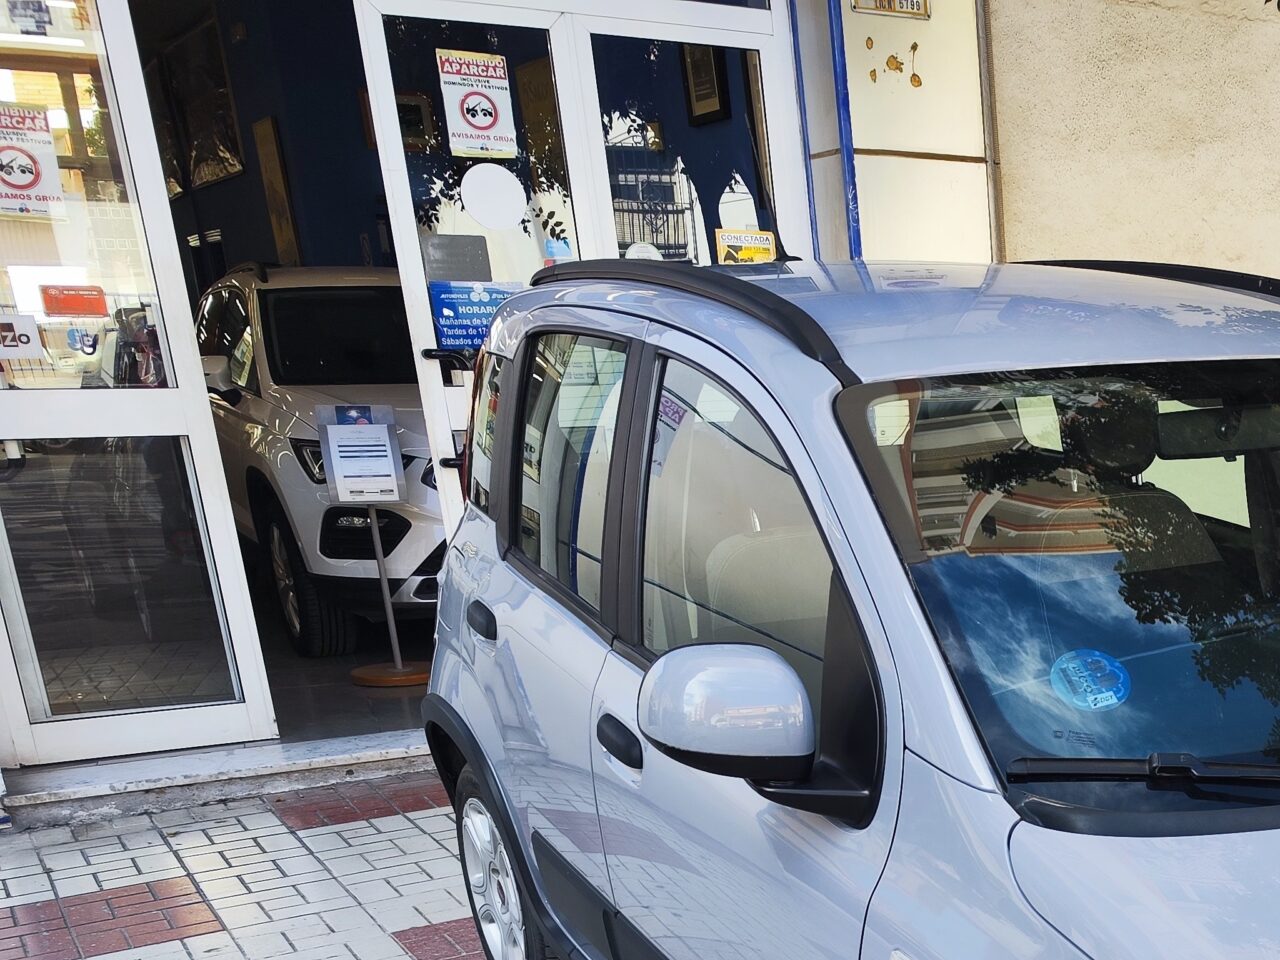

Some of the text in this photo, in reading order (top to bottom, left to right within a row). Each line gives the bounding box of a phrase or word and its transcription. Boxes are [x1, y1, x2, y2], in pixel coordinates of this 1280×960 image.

[443, 63, 506, 78] APARCAR
[443, 80, 475, 88] DOMINGOS
[0, 116, 49, 131] RCAR
[451, 132, 491, 141] AVISAMOS
[721, 234, 770, 242] CONECTADA
[440, 317, 470, 325] Mañanas
[443, 327, 467, 335] Tardes
[442, 337, 471, 345] Sábados
